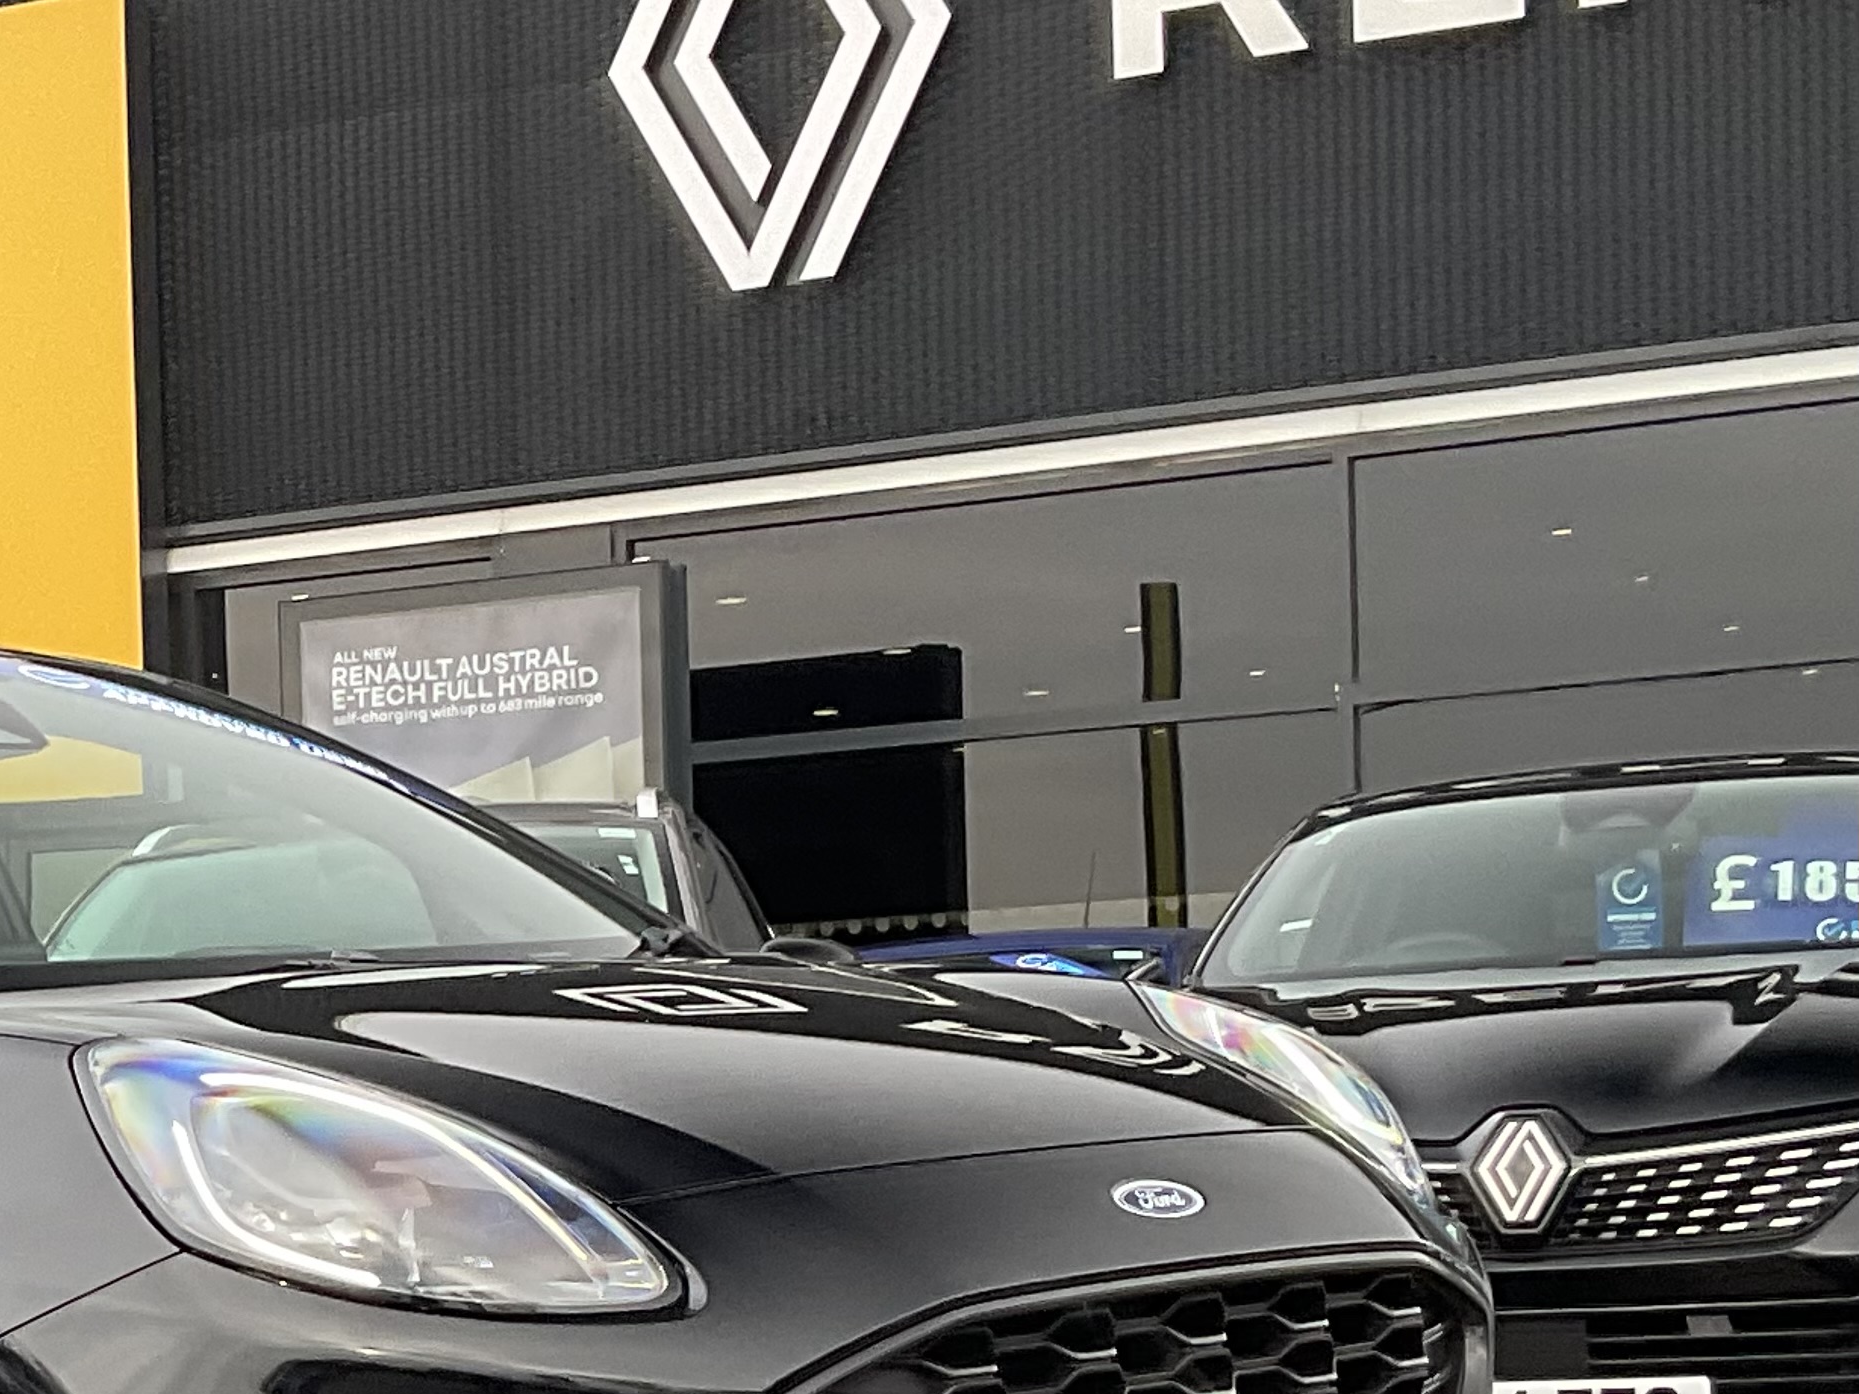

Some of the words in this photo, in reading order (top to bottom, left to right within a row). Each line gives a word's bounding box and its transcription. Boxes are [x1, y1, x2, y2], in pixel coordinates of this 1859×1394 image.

[331, 657, 453, 688] RENAULT
[456, 645, 579, 678] AUSTRAL
[333, 651, 360, 664] ALL
[363, 646, 398, 661] NEW
[331, 684, 426, 711] E-TECH
[432, 679, 493, 704] FULL
[498, 666, 599, 697] HYBRID
[460, 704, 478, 718] up
[524, 694, 555, 710] mile
[557, 692, 603, 708] range
